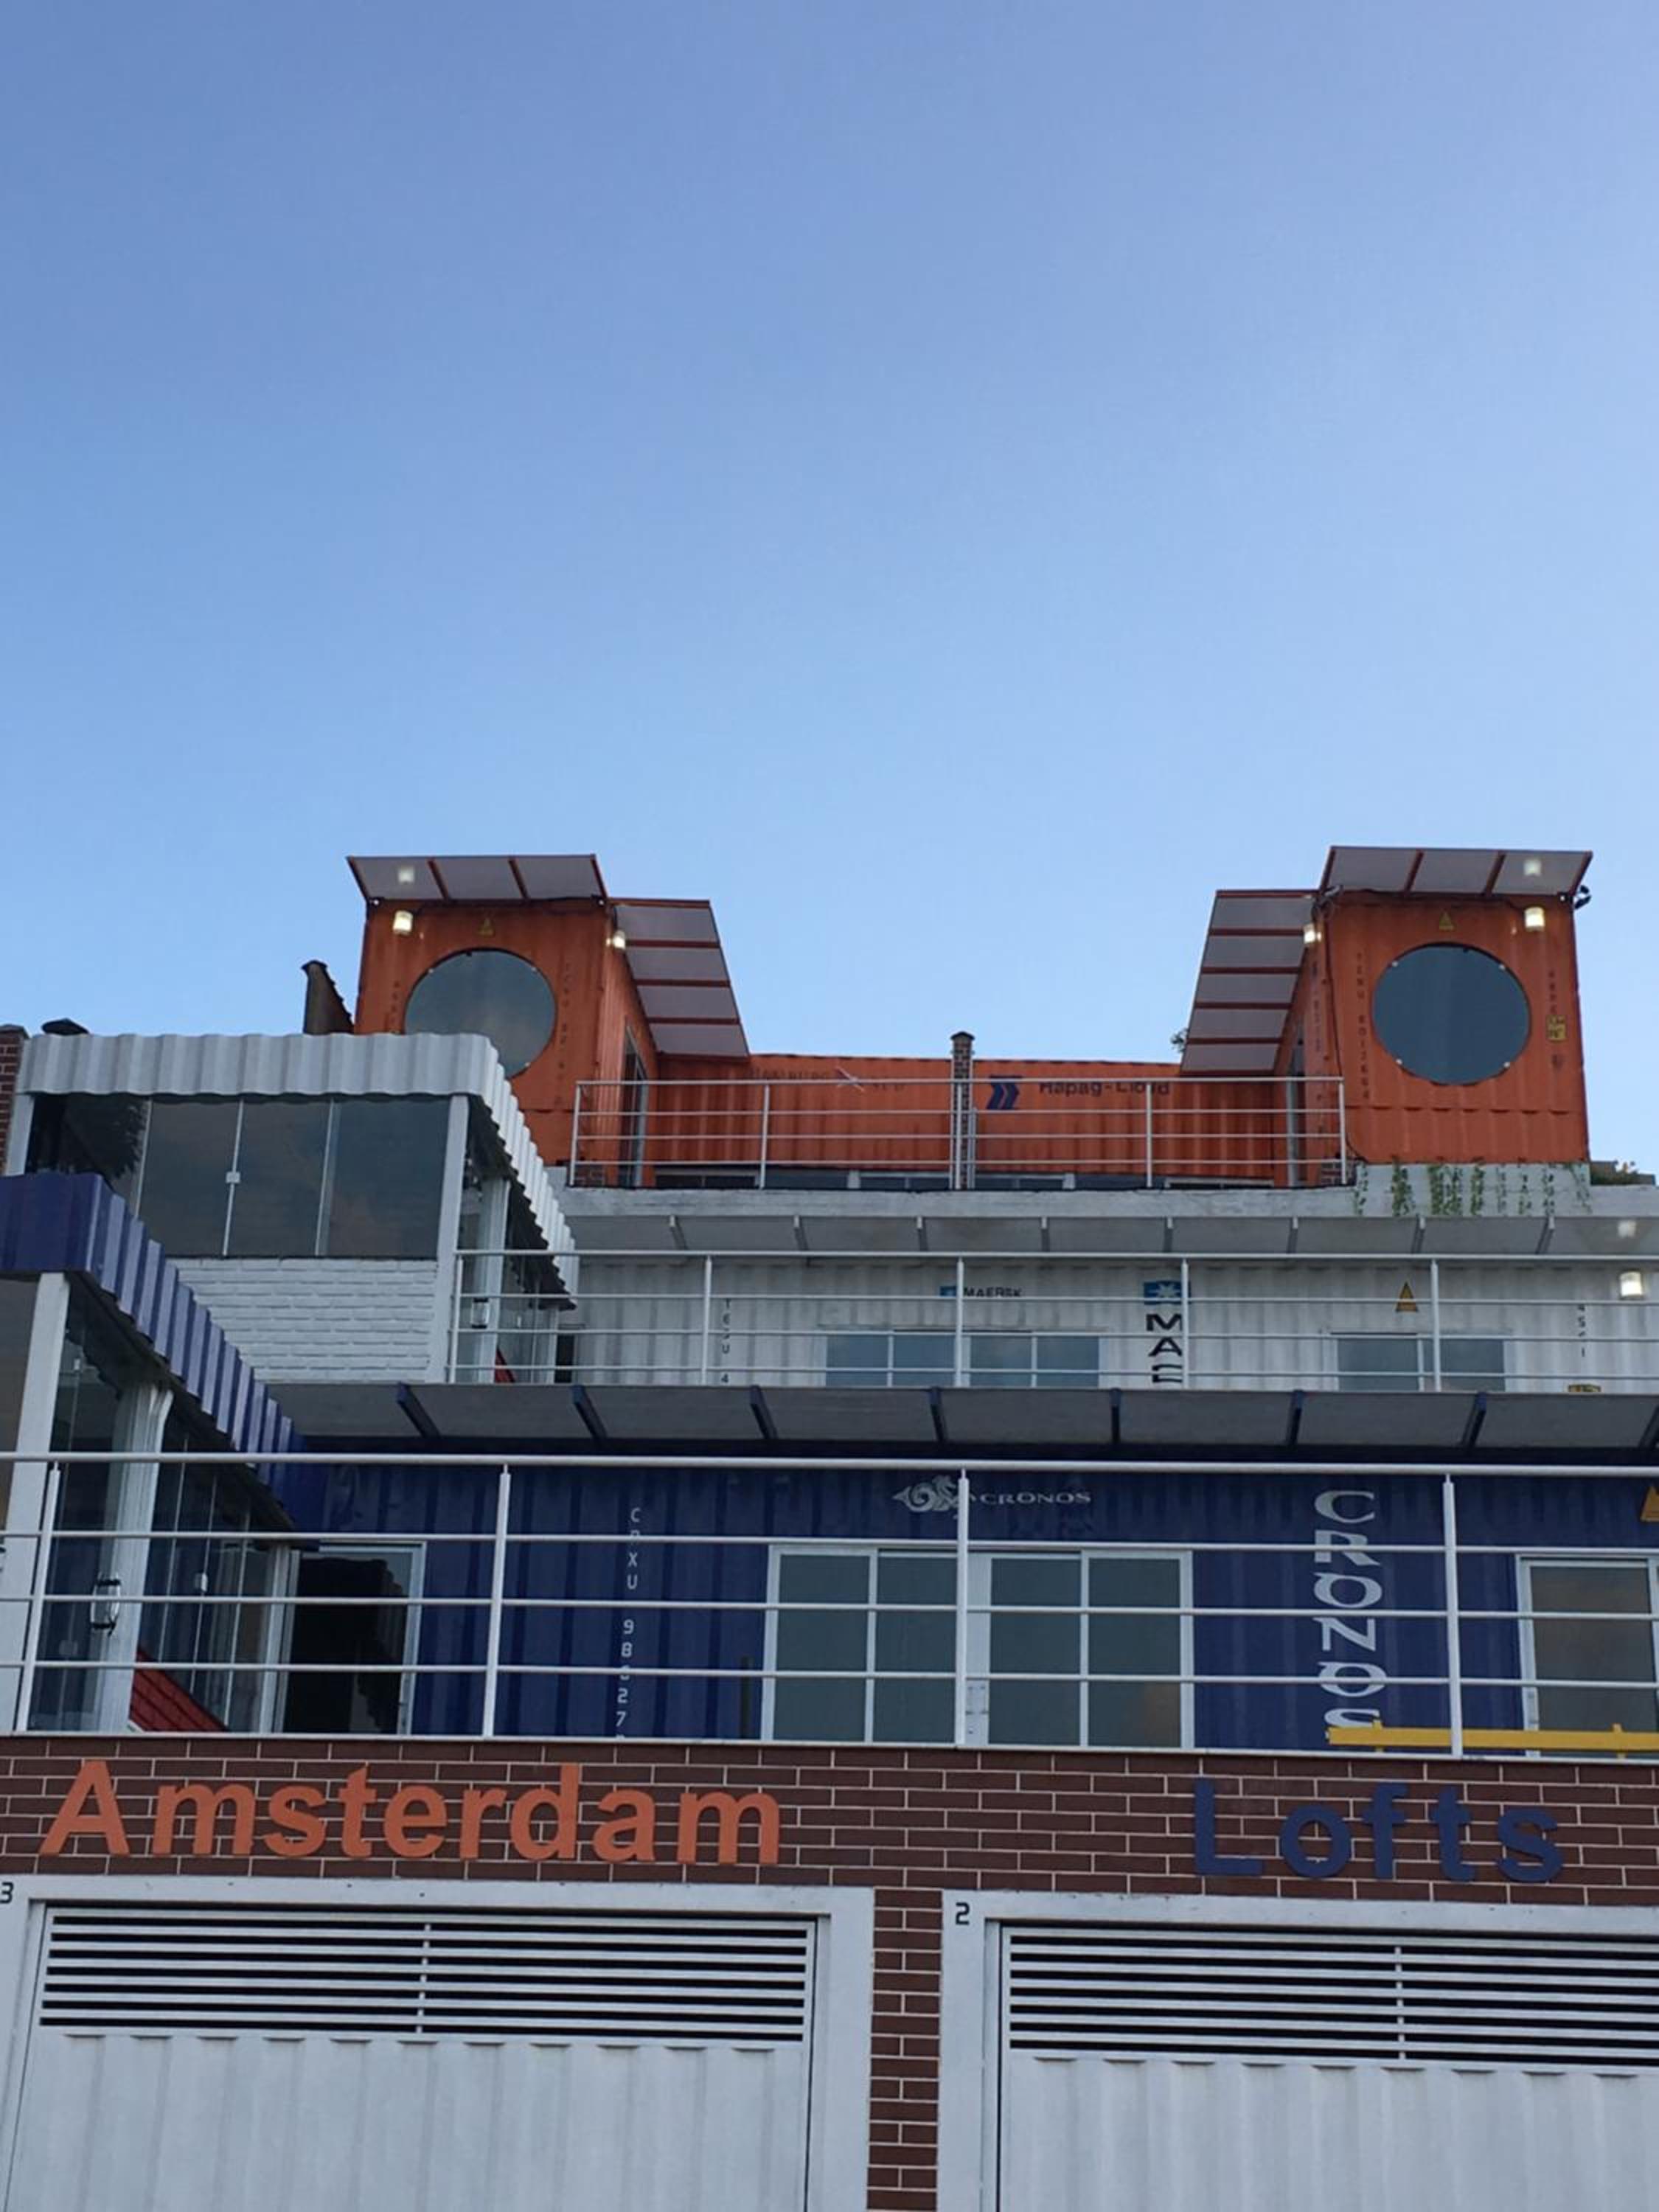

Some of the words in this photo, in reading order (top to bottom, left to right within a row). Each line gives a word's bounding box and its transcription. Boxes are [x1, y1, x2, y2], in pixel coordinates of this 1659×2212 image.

[979, 1492, 1091, 1505] CRONOS
[38, 1760, 781, 1866] Amsterdam
[1193, 1777, 1564, 1883] Lofts
[0, 1882, 14, 1904] 3
[955, 1902, 970, 1925] 2
